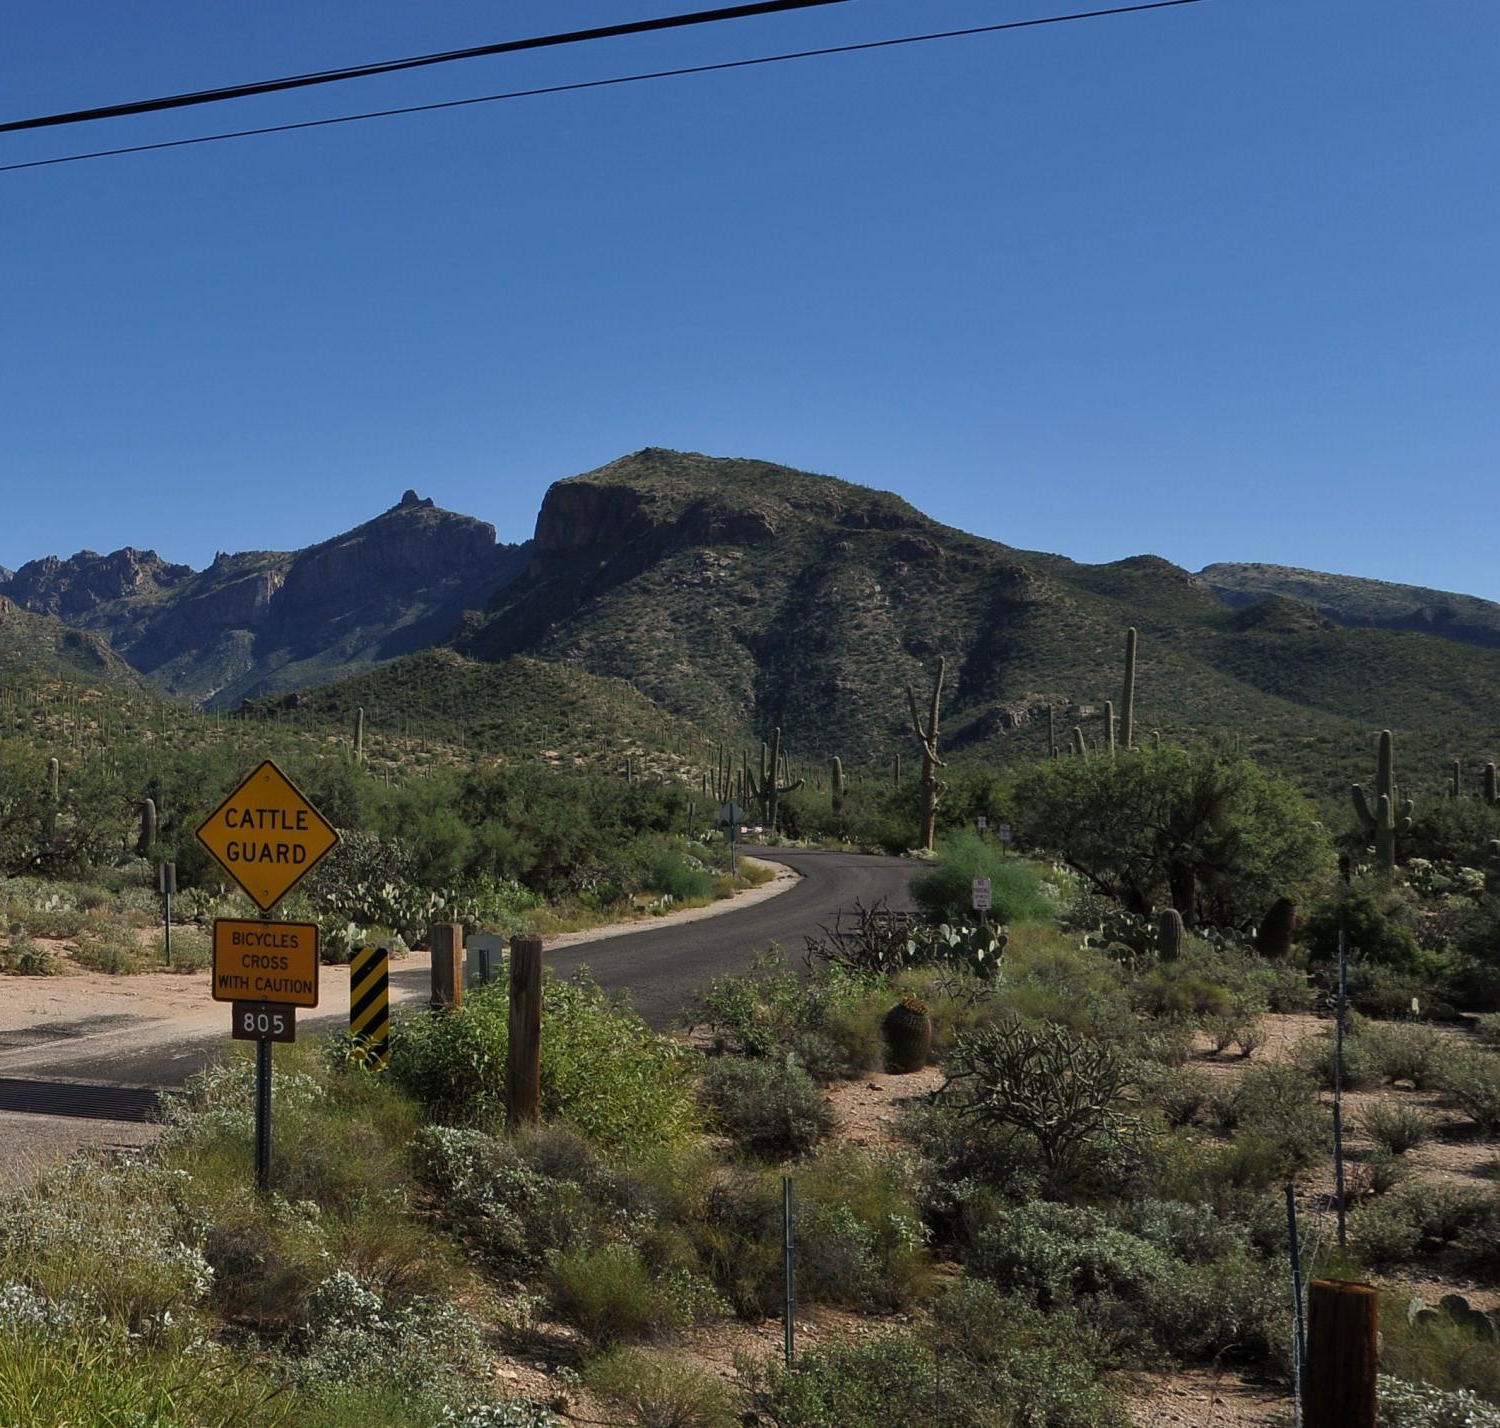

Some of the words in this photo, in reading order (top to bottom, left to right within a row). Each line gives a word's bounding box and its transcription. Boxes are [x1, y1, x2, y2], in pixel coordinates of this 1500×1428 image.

[225, 808, 309, 831] CATTLE
[226, 841, 307, 864] GUARD
[232, 931, 299, 949] BICYCLES
[242, 955, 289, 970] CROSS
[218, 975, 250, 991] WITH
[255, 977, 313, 994] CAUTION
[243, 1012, 285, 1034] 805
